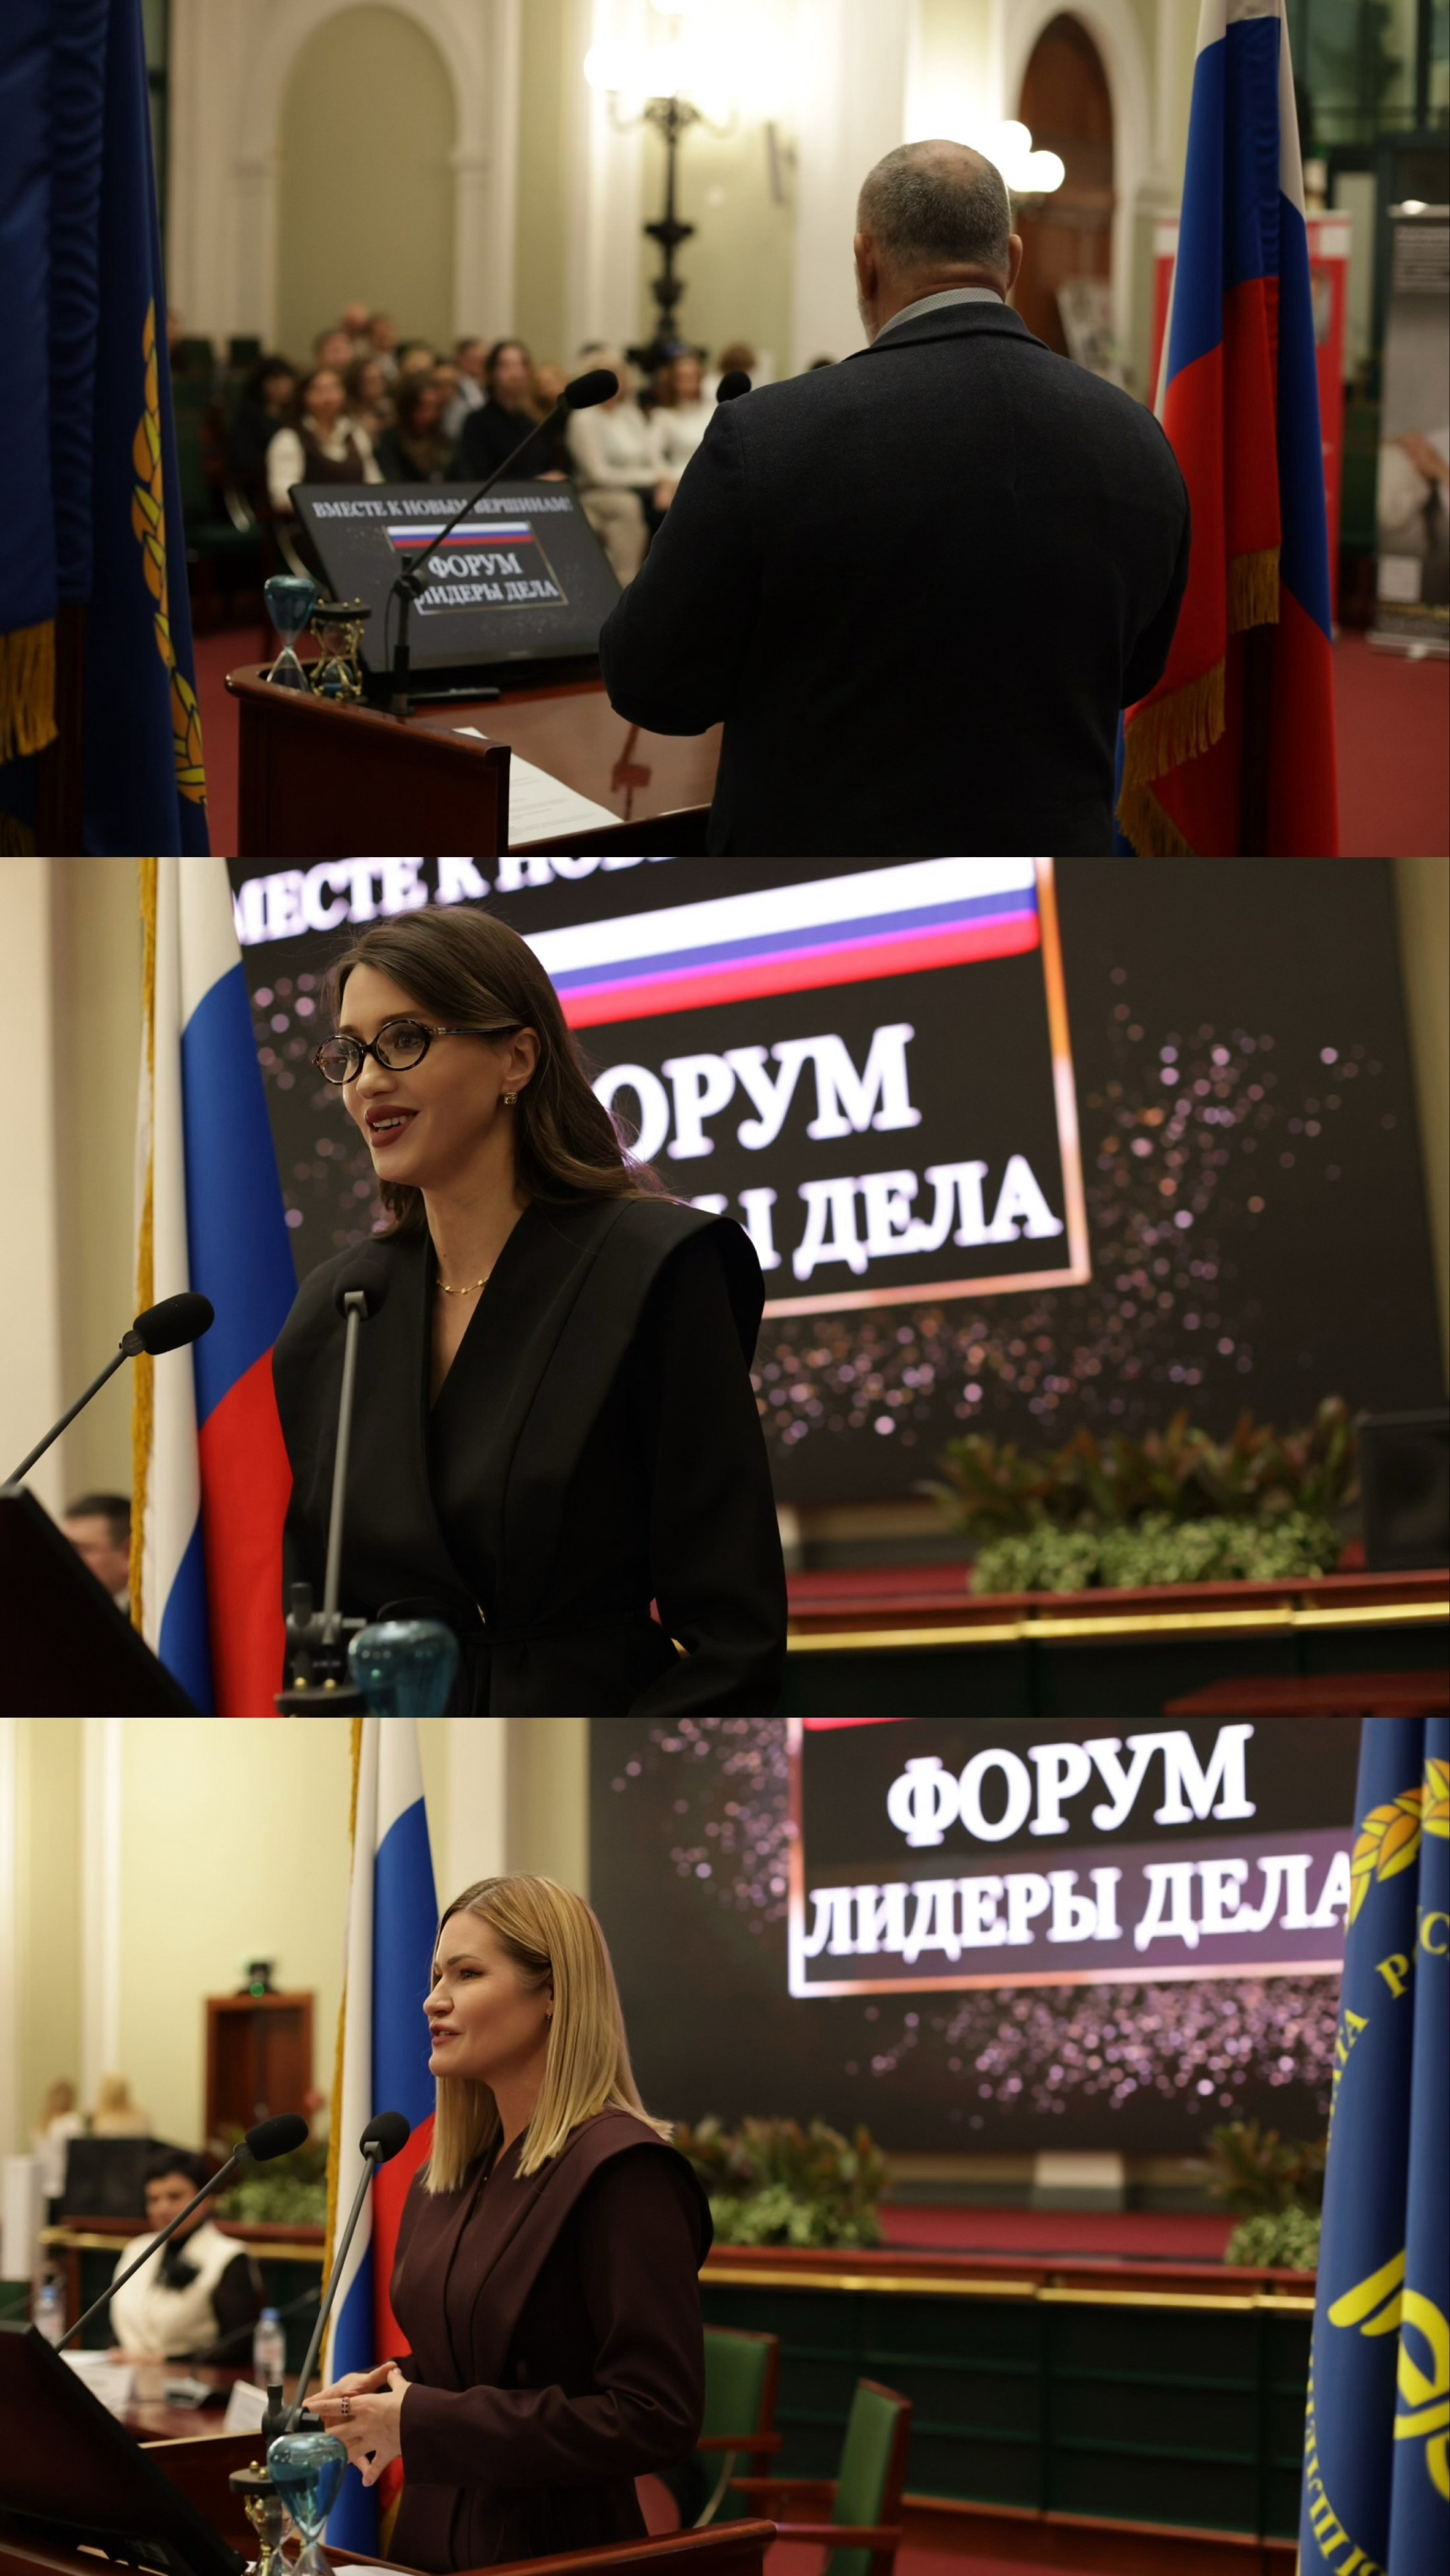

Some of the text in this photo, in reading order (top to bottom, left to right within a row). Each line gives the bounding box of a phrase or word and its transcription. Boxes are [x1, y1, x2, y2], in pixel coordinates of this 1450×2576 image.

[313, 501, 387, 518] ВМЕСТЕ
[386, 501, 403, 516] К
[428, 553, 523, 579] ФОРУМ
[504, 579, 559, 602] ДЕЛА
[591, 1023, 922, 1169] ОРУМ
[793, 1155, 1064, 1281] ДЕЛА
[887, 1723, 1256, 1847] ФОРУМ
[802, 1851, 1351, 1963] ЛИДЕРЫ ДЕЛА
